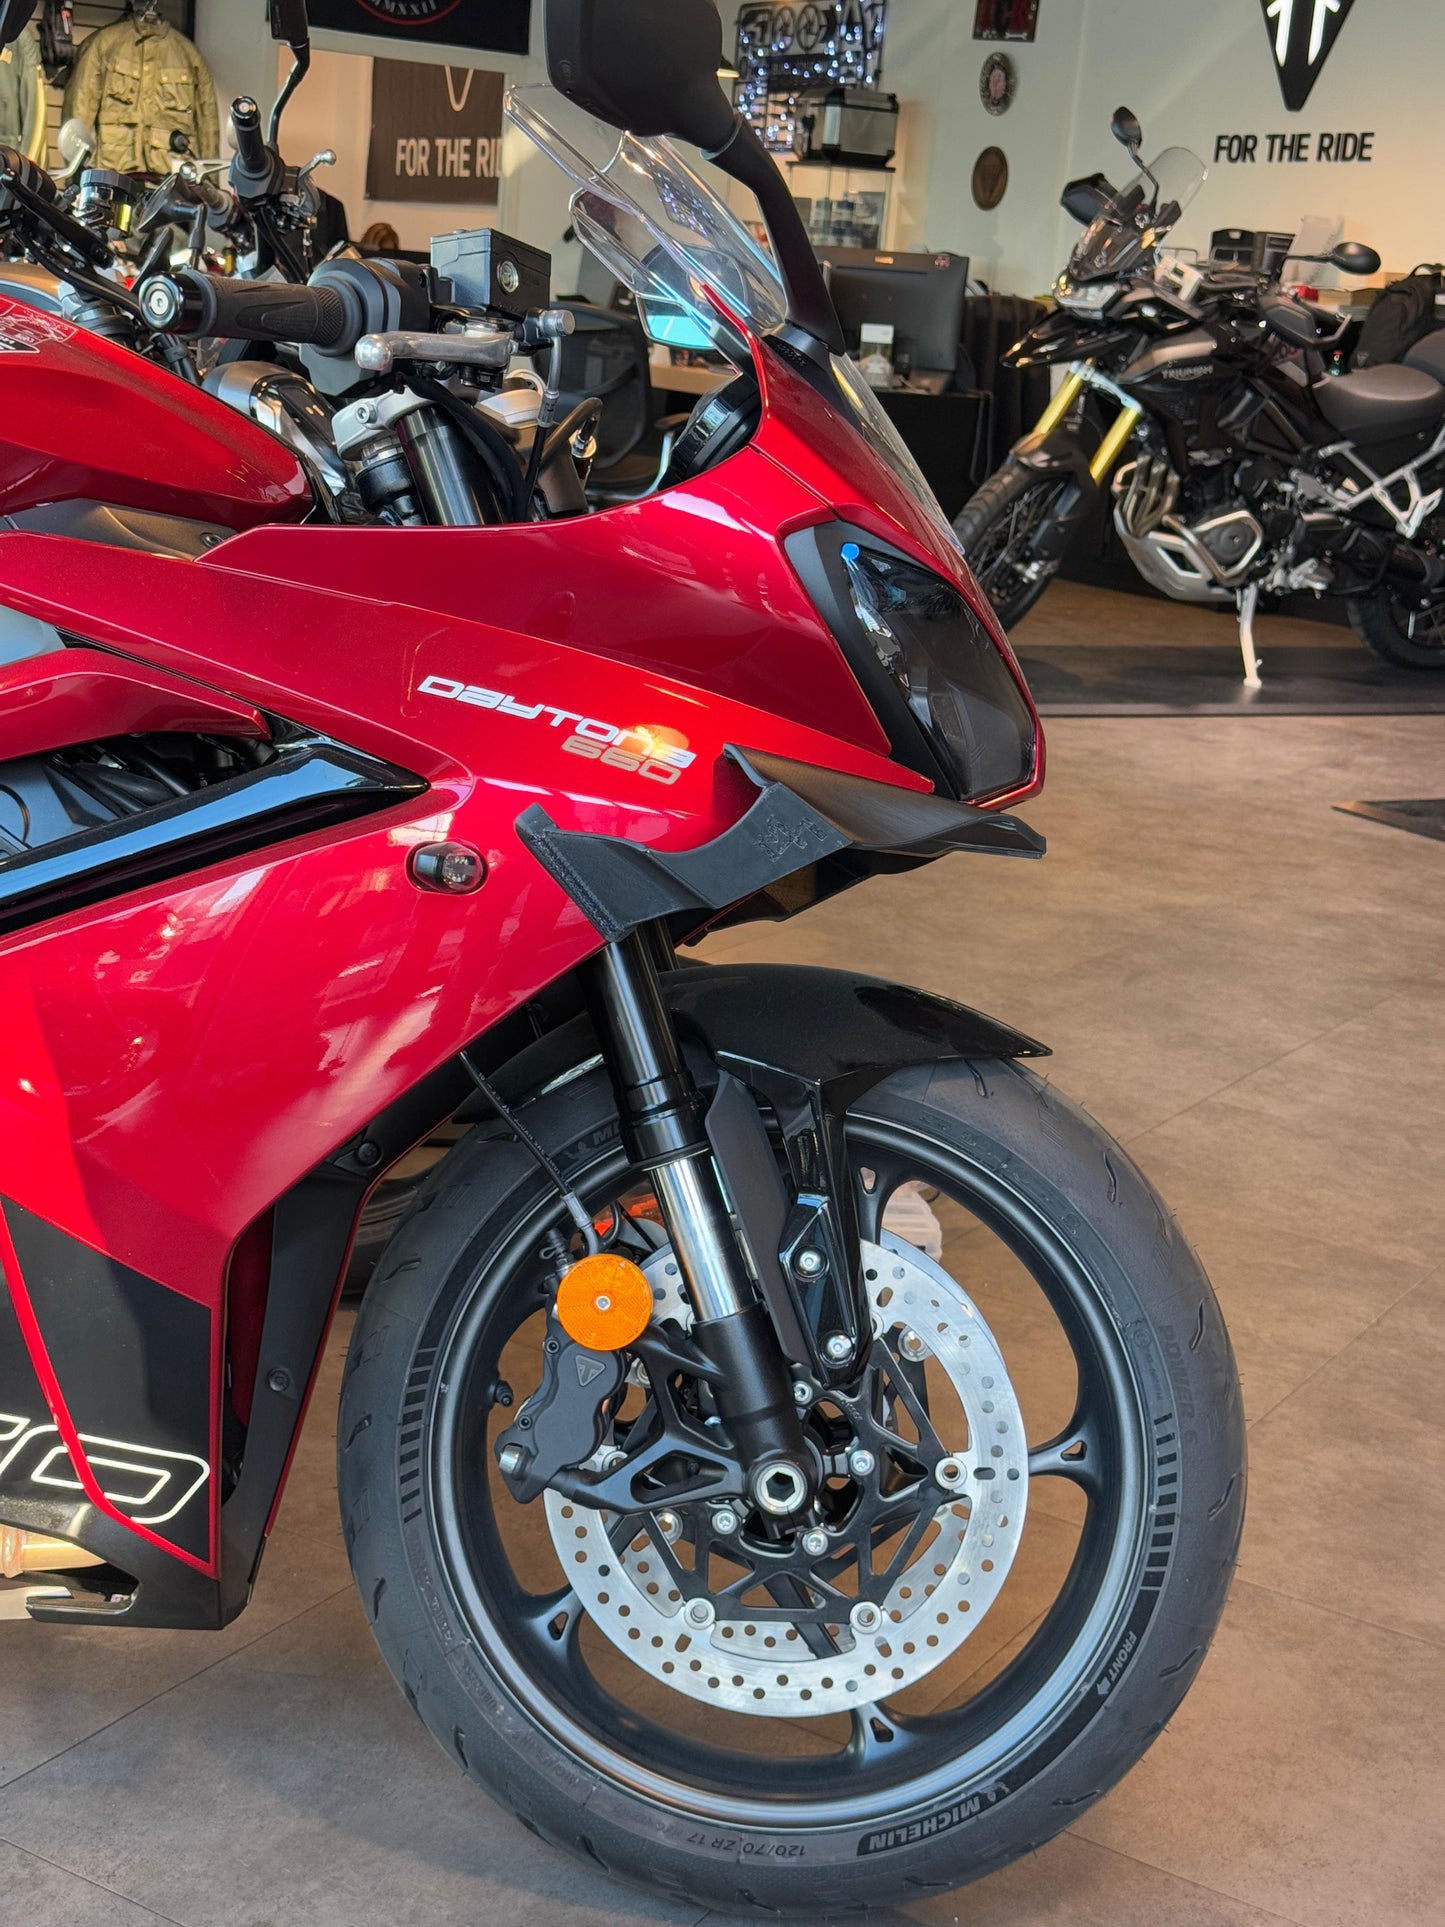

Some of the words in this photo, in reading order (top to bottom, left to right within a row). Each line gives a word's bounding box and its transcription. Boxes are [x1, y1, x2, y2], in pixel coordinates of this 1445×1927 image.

[396, 138, 430, 176] FOR
[435, 138, 471, 177] THE
[1214, 134, 1258, 163] FOR
[1265, 133, 1311, 162] THE
[1316, 132, 1375, 162] RIDE
[561, 735, 681, 785] 660
[1108, 1630, 1137, 1682] FRONT
[686, 1832, 706, 1845] 17
[868, 1796, 981, 1851] MICHELIN
[711, 1837, 737, 1851] ZR
[742, 1843, 806, 1857] 120/70
